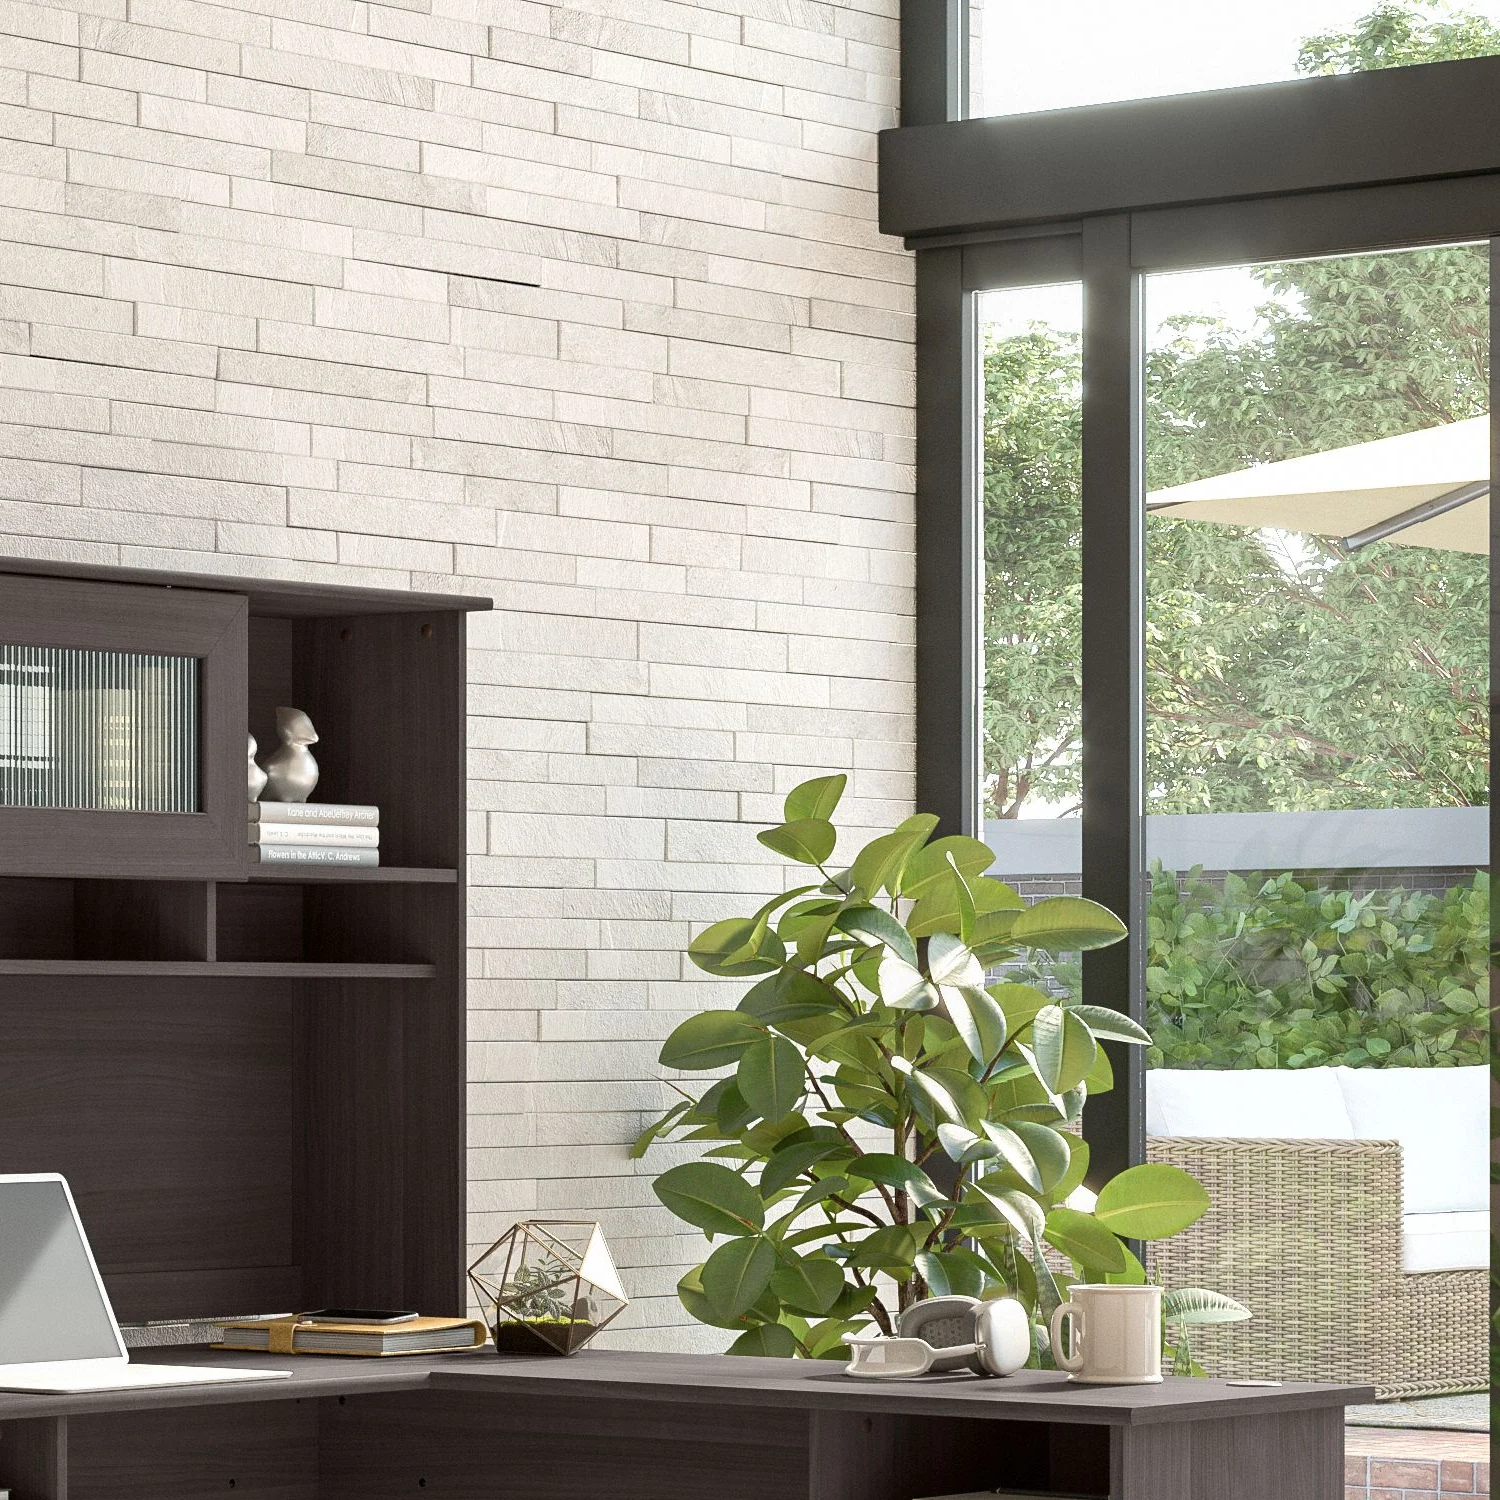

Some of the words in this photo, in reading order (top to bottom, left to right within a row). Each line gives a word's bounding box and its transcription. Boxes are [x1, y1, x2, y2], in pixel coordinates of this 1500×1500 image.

[287, 808, 305, 817] Kane
[305, 809, 318, 817] and
[354, 811, 374, 820] Archer
[268, 850, 290, 859] Flowers
[336, 852, 361, 861] Andrews
